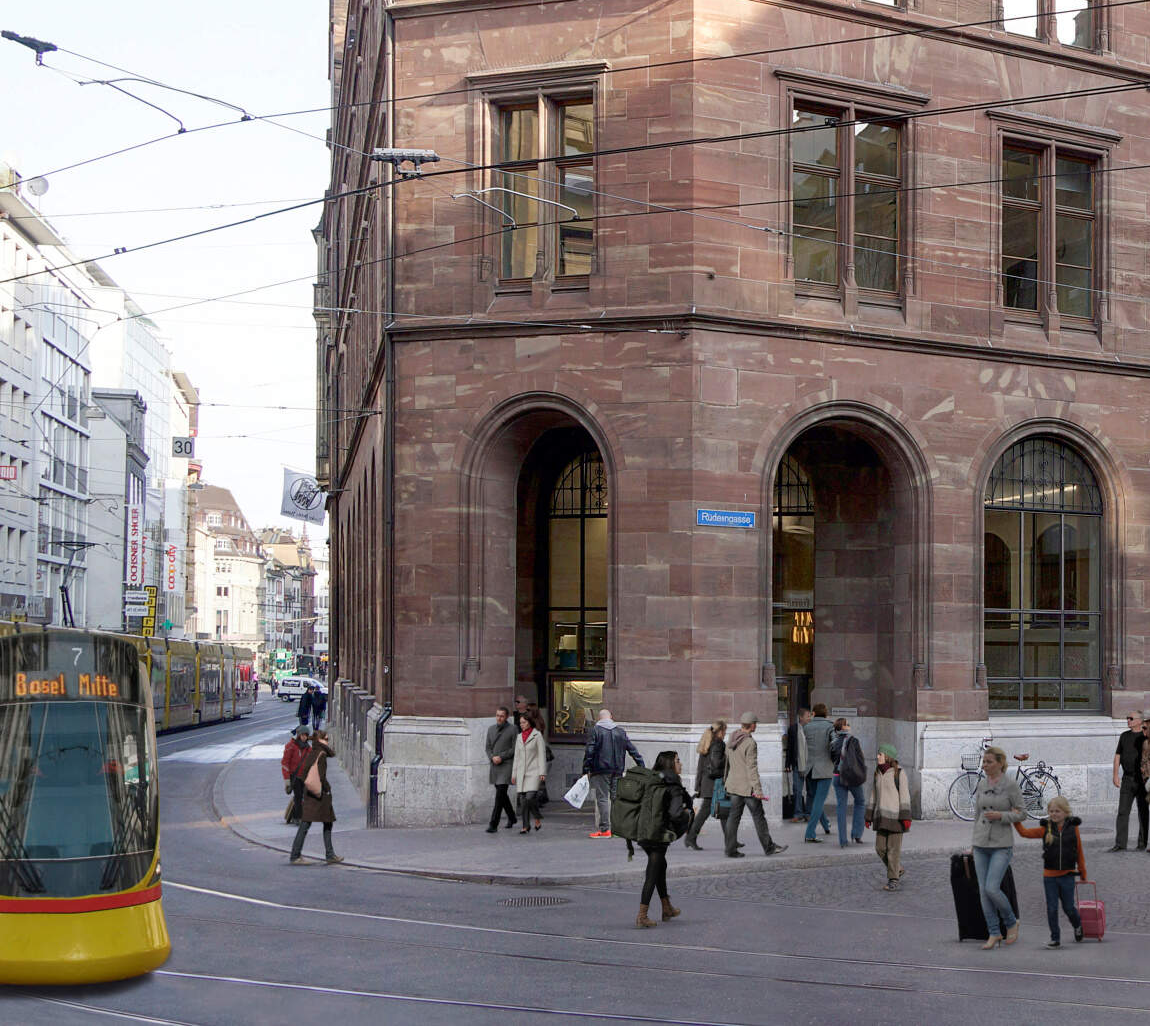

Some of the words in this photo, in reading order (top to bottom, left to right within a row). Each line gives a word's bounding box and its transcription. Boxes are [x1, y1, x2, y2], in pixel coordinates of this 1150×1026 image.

[174, 440, 193, 455] 30
[71, 647, 82, 666] 7
[16, 672, 66, 696] Basel
[79, 674, 119, 696] Mitte
